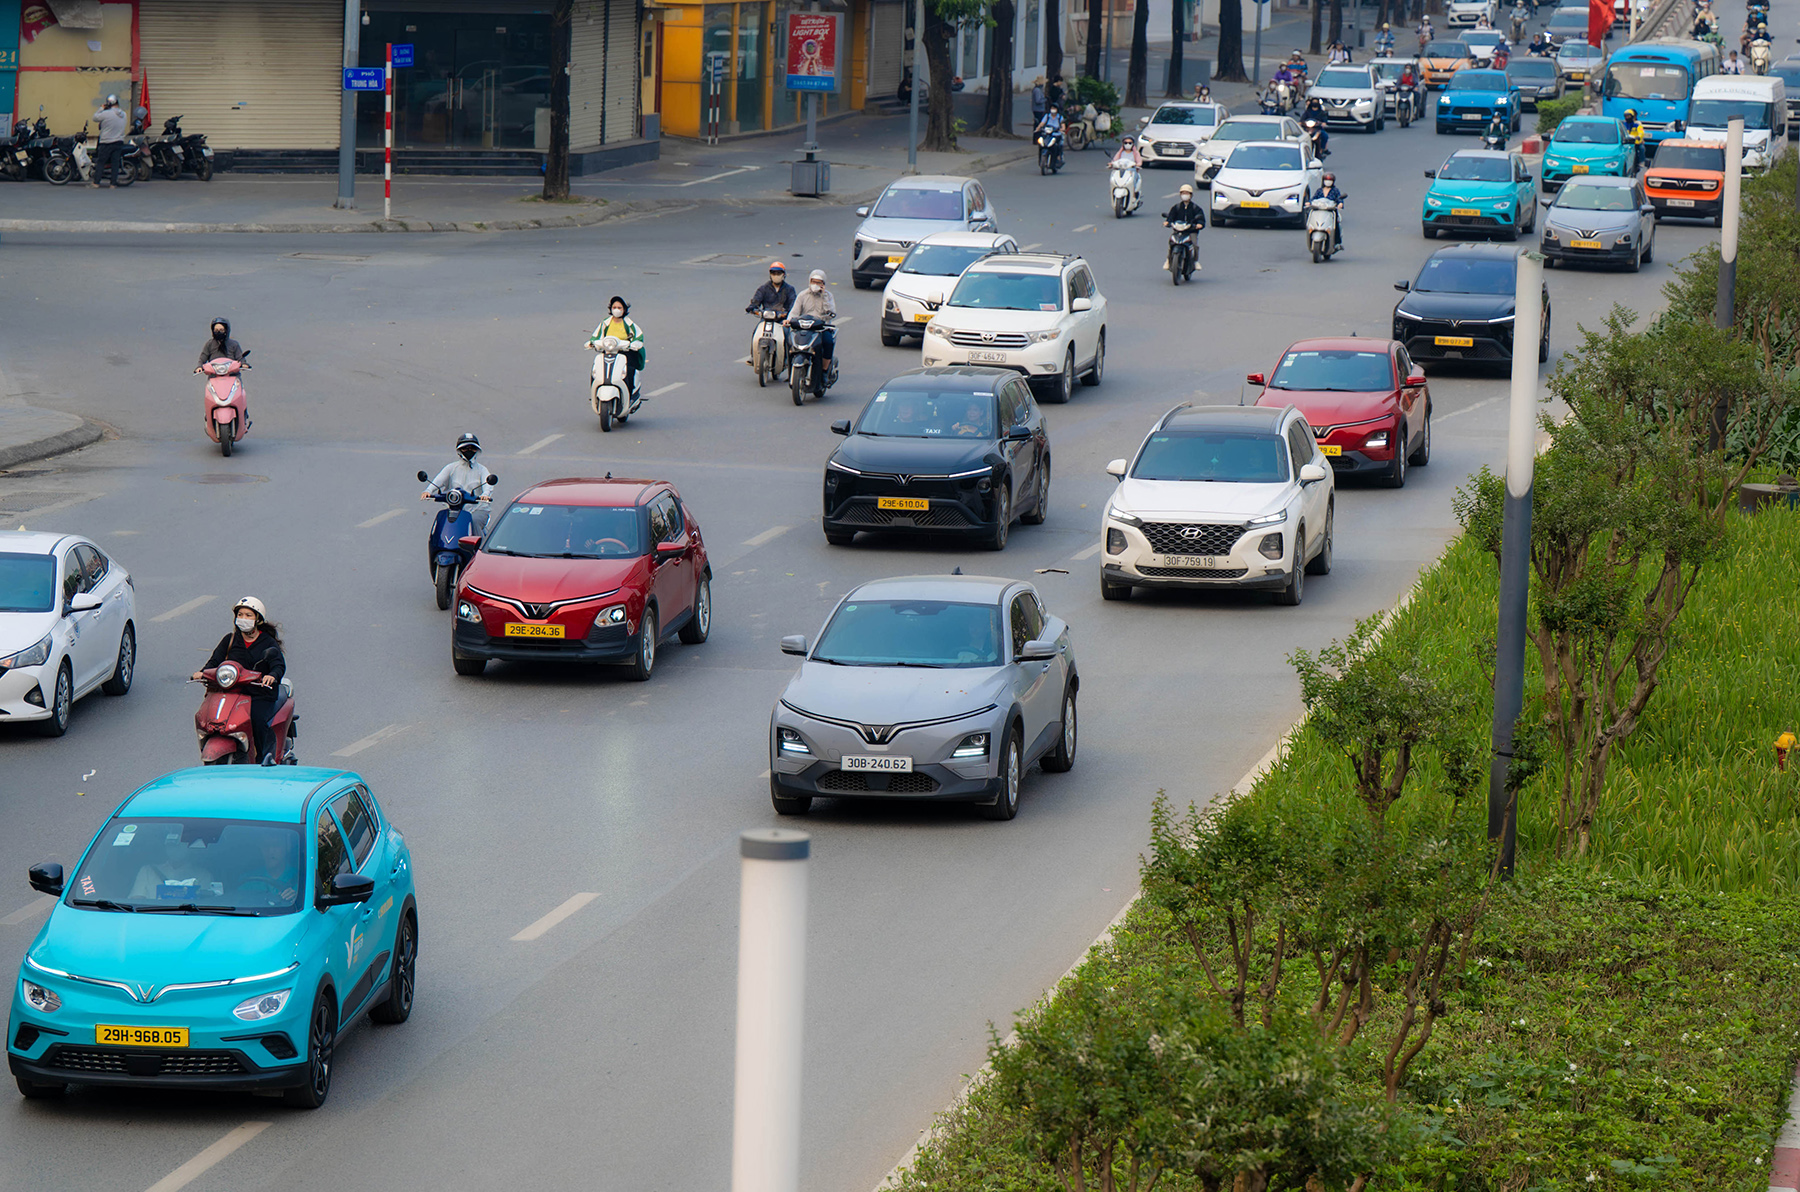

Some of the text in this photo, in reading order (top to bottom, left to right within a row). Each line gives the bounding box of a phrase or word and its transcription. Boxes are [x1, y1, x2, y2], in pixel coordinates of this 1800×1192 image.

[882, 500, 924, 508] 29E-610.04
[1166, 556, 1213, 567] 30F-759.19
[510, 626, 560, 636] 29E-284.36
[848, 758, 906, 769] 30B-240.62
[80, 876, 95, 895] TAXI
[104, 1029, 181, 1043] 29H-968.05
